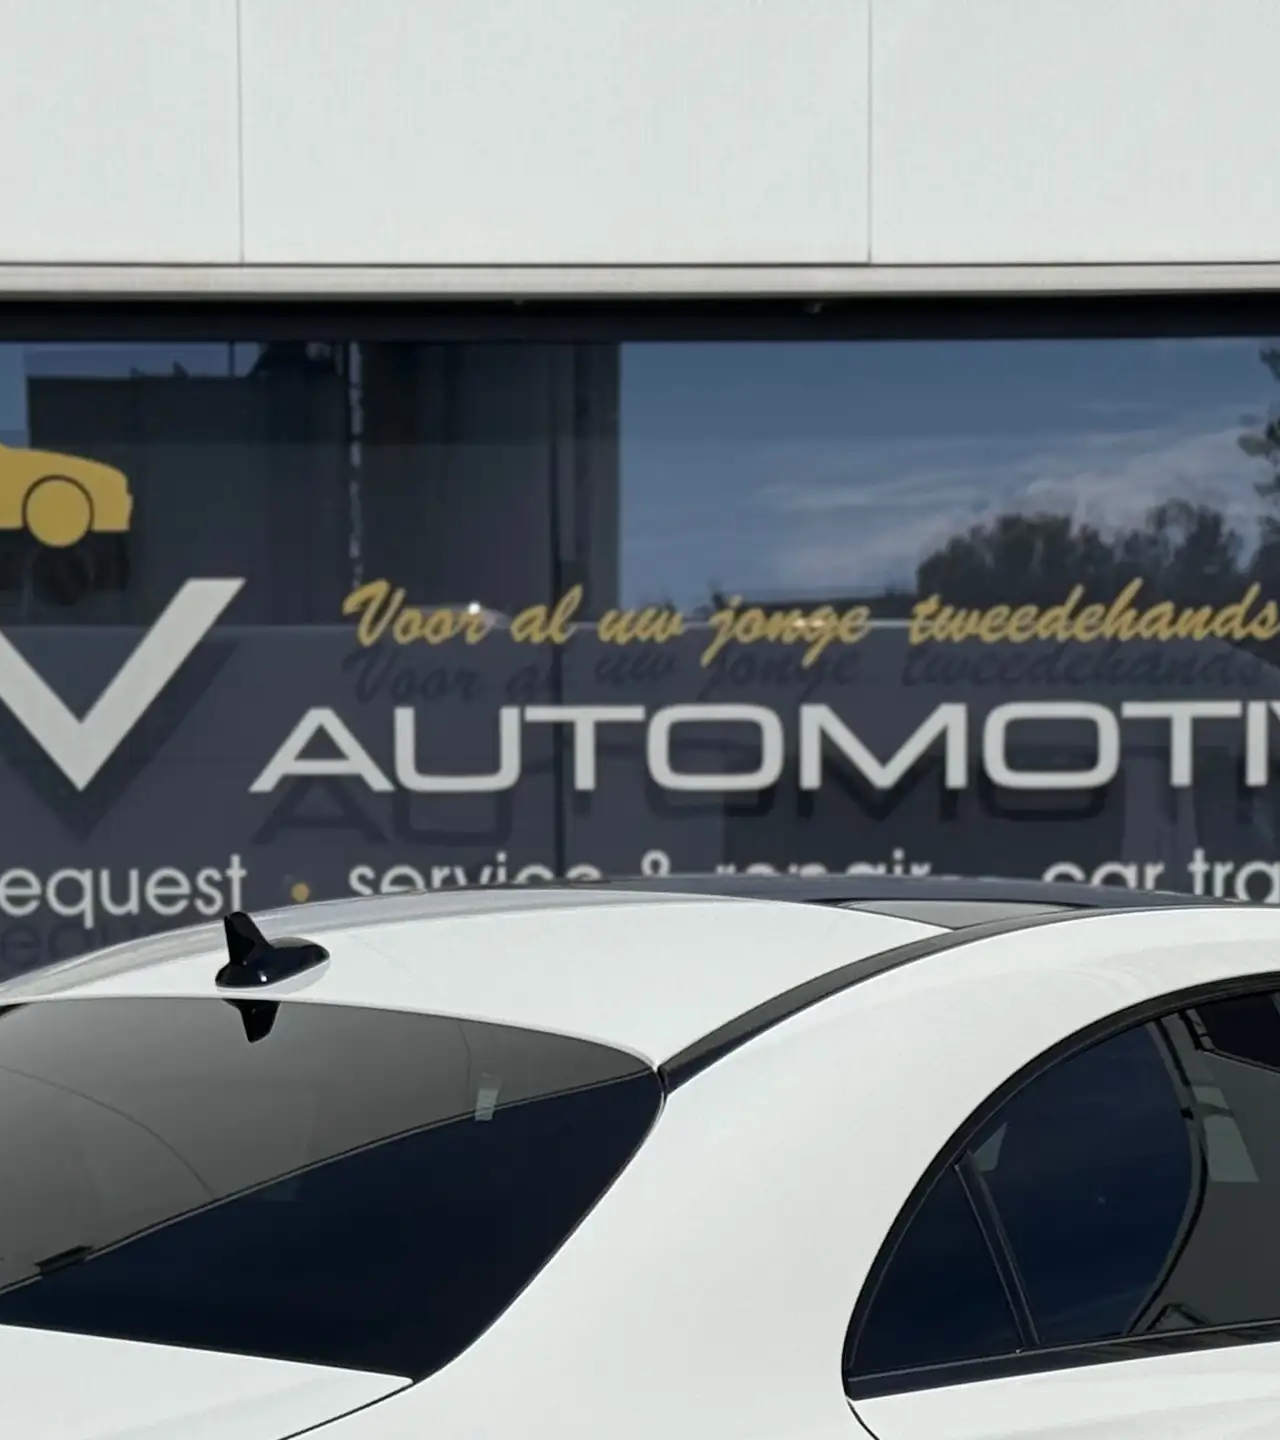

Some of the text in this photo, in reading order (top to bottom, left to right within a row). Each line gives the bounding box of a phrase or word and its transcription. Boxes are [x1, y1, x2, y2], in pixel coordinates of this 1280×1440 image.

[343, 579, 494, 648] Voor
[510, 584, 584, 645] al
[598, 603, 684, 645] uw
[700, 592, 873, 668] jonge
